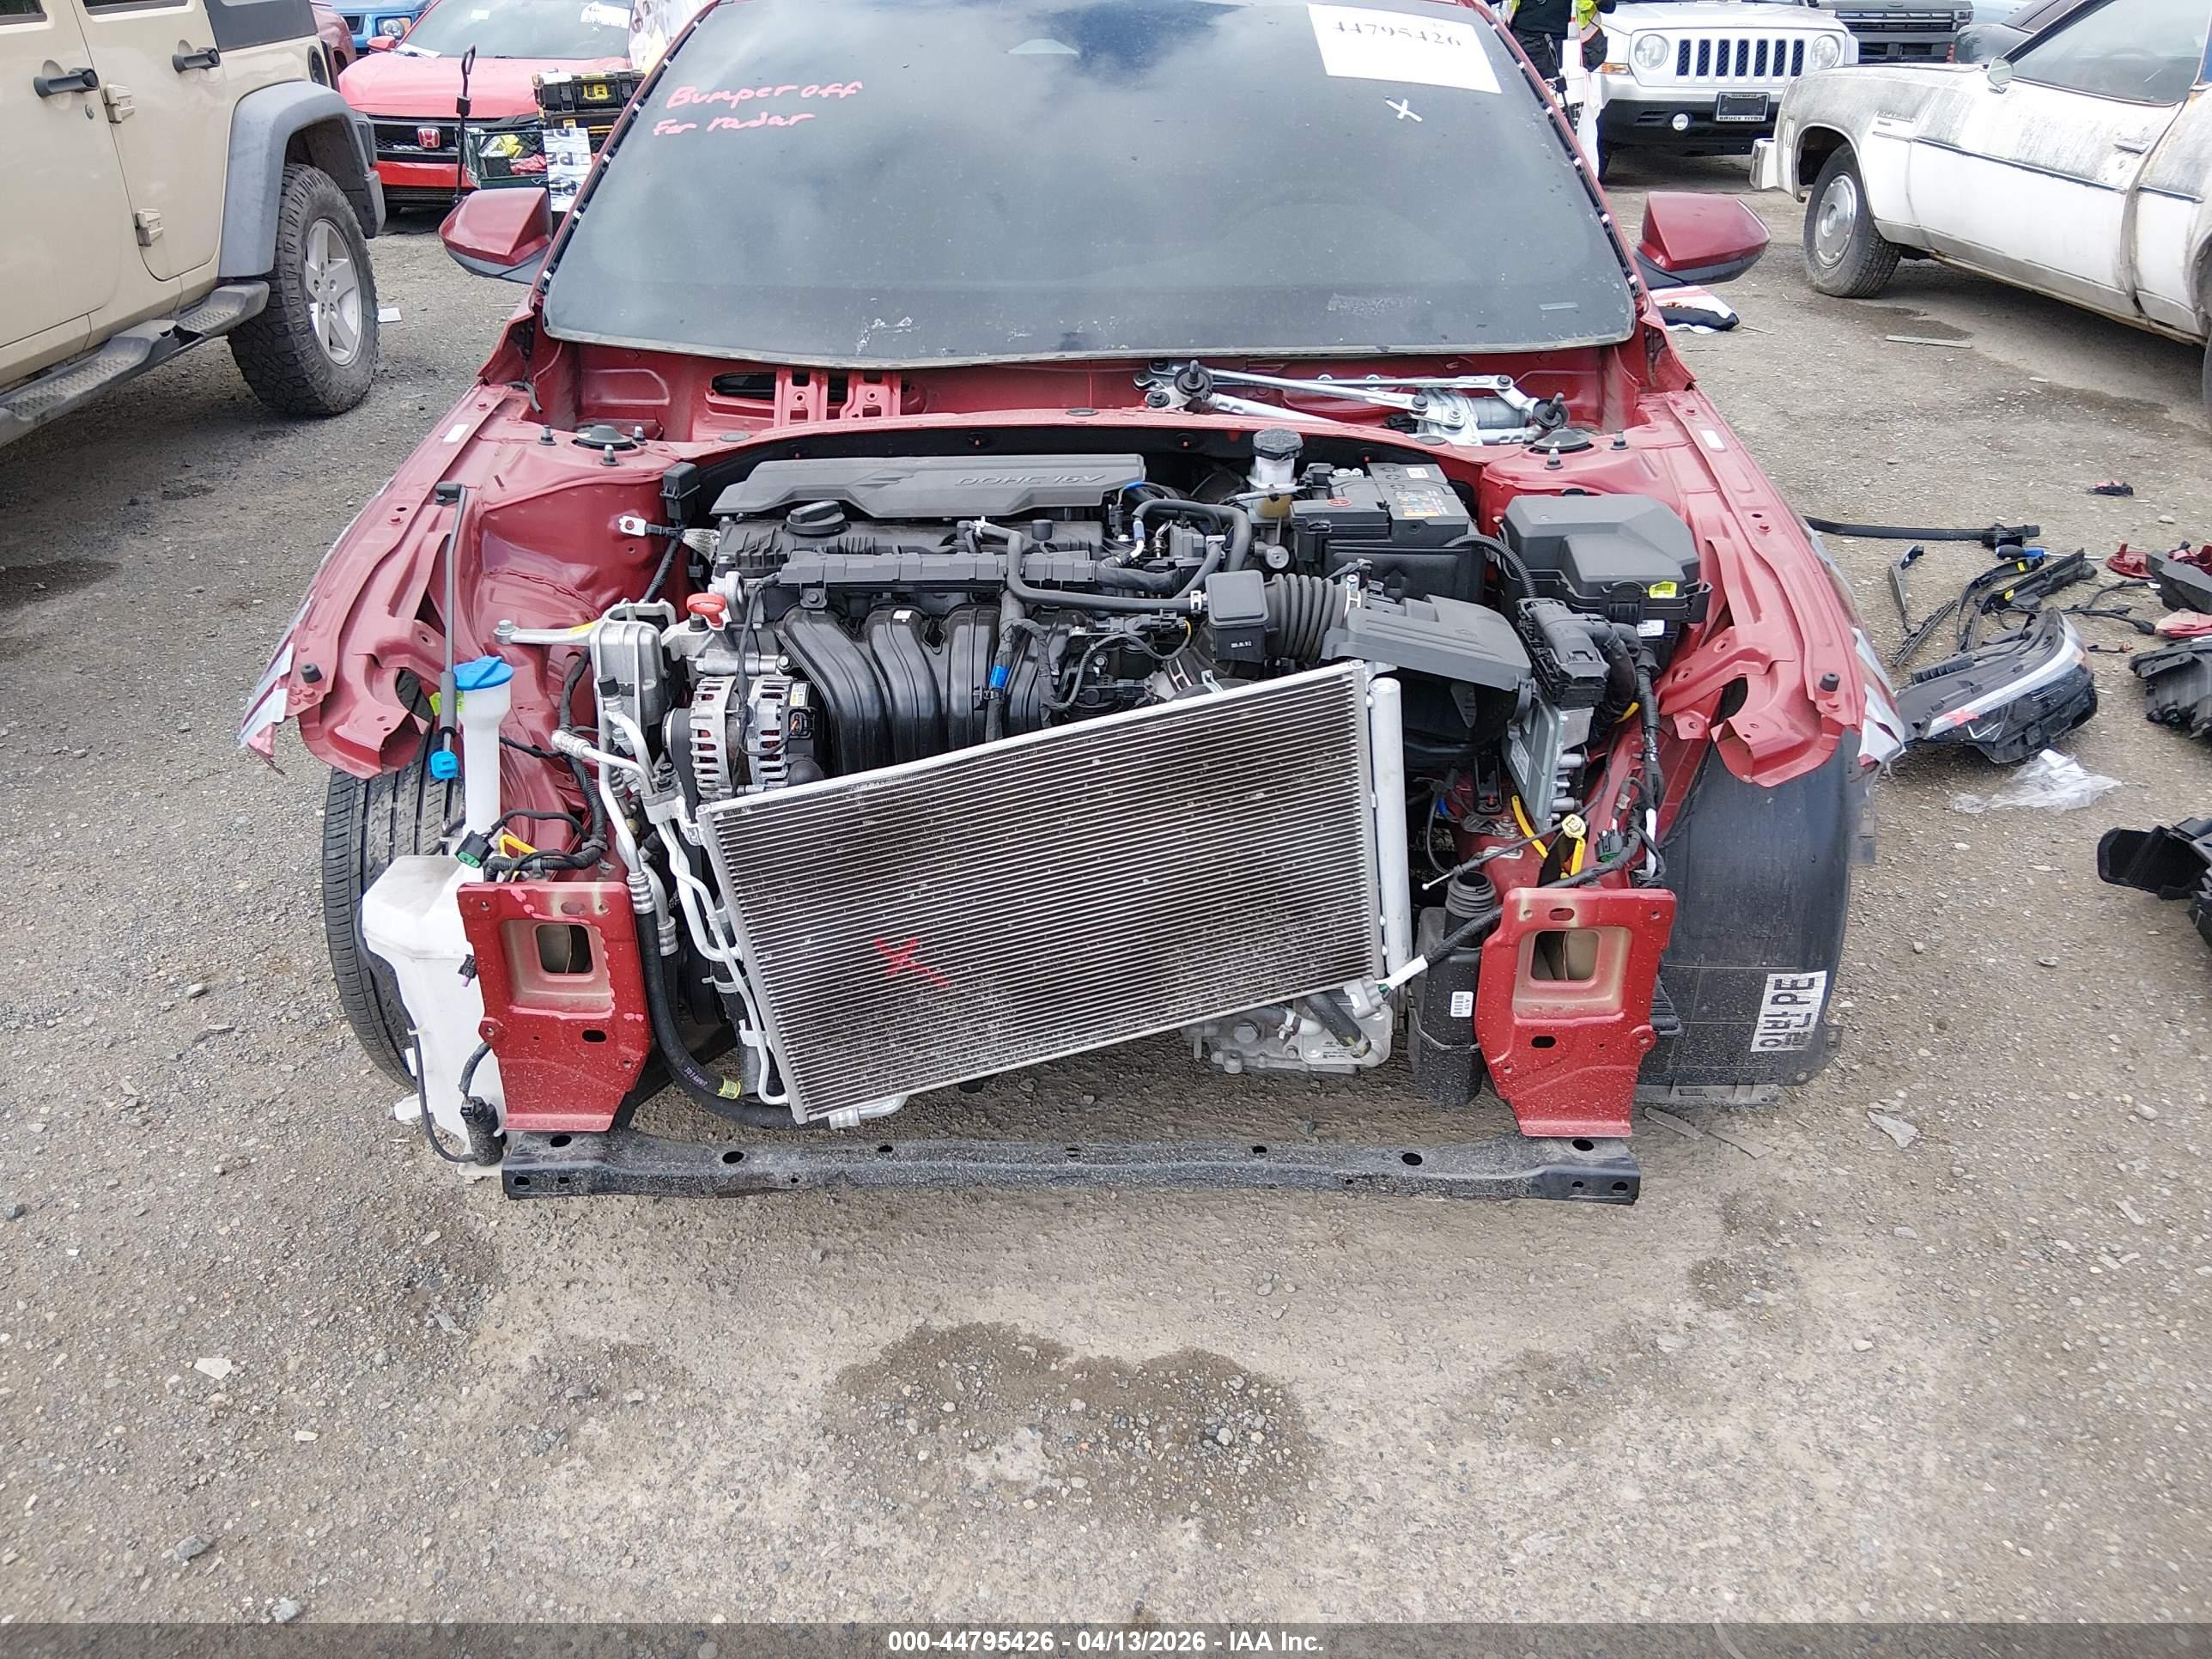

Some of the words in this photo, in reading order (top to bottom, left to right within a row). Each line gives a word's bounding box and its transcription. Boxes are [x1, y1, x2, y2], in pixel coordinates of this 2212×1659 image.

[666, 85, 798, 109] Bumper
[800, 81, 863, 99] off
[707, 112, 815, 131] radar
[955, 475, 1047, 486] DOHC
[1053, 474, 1107, 484] 16V
